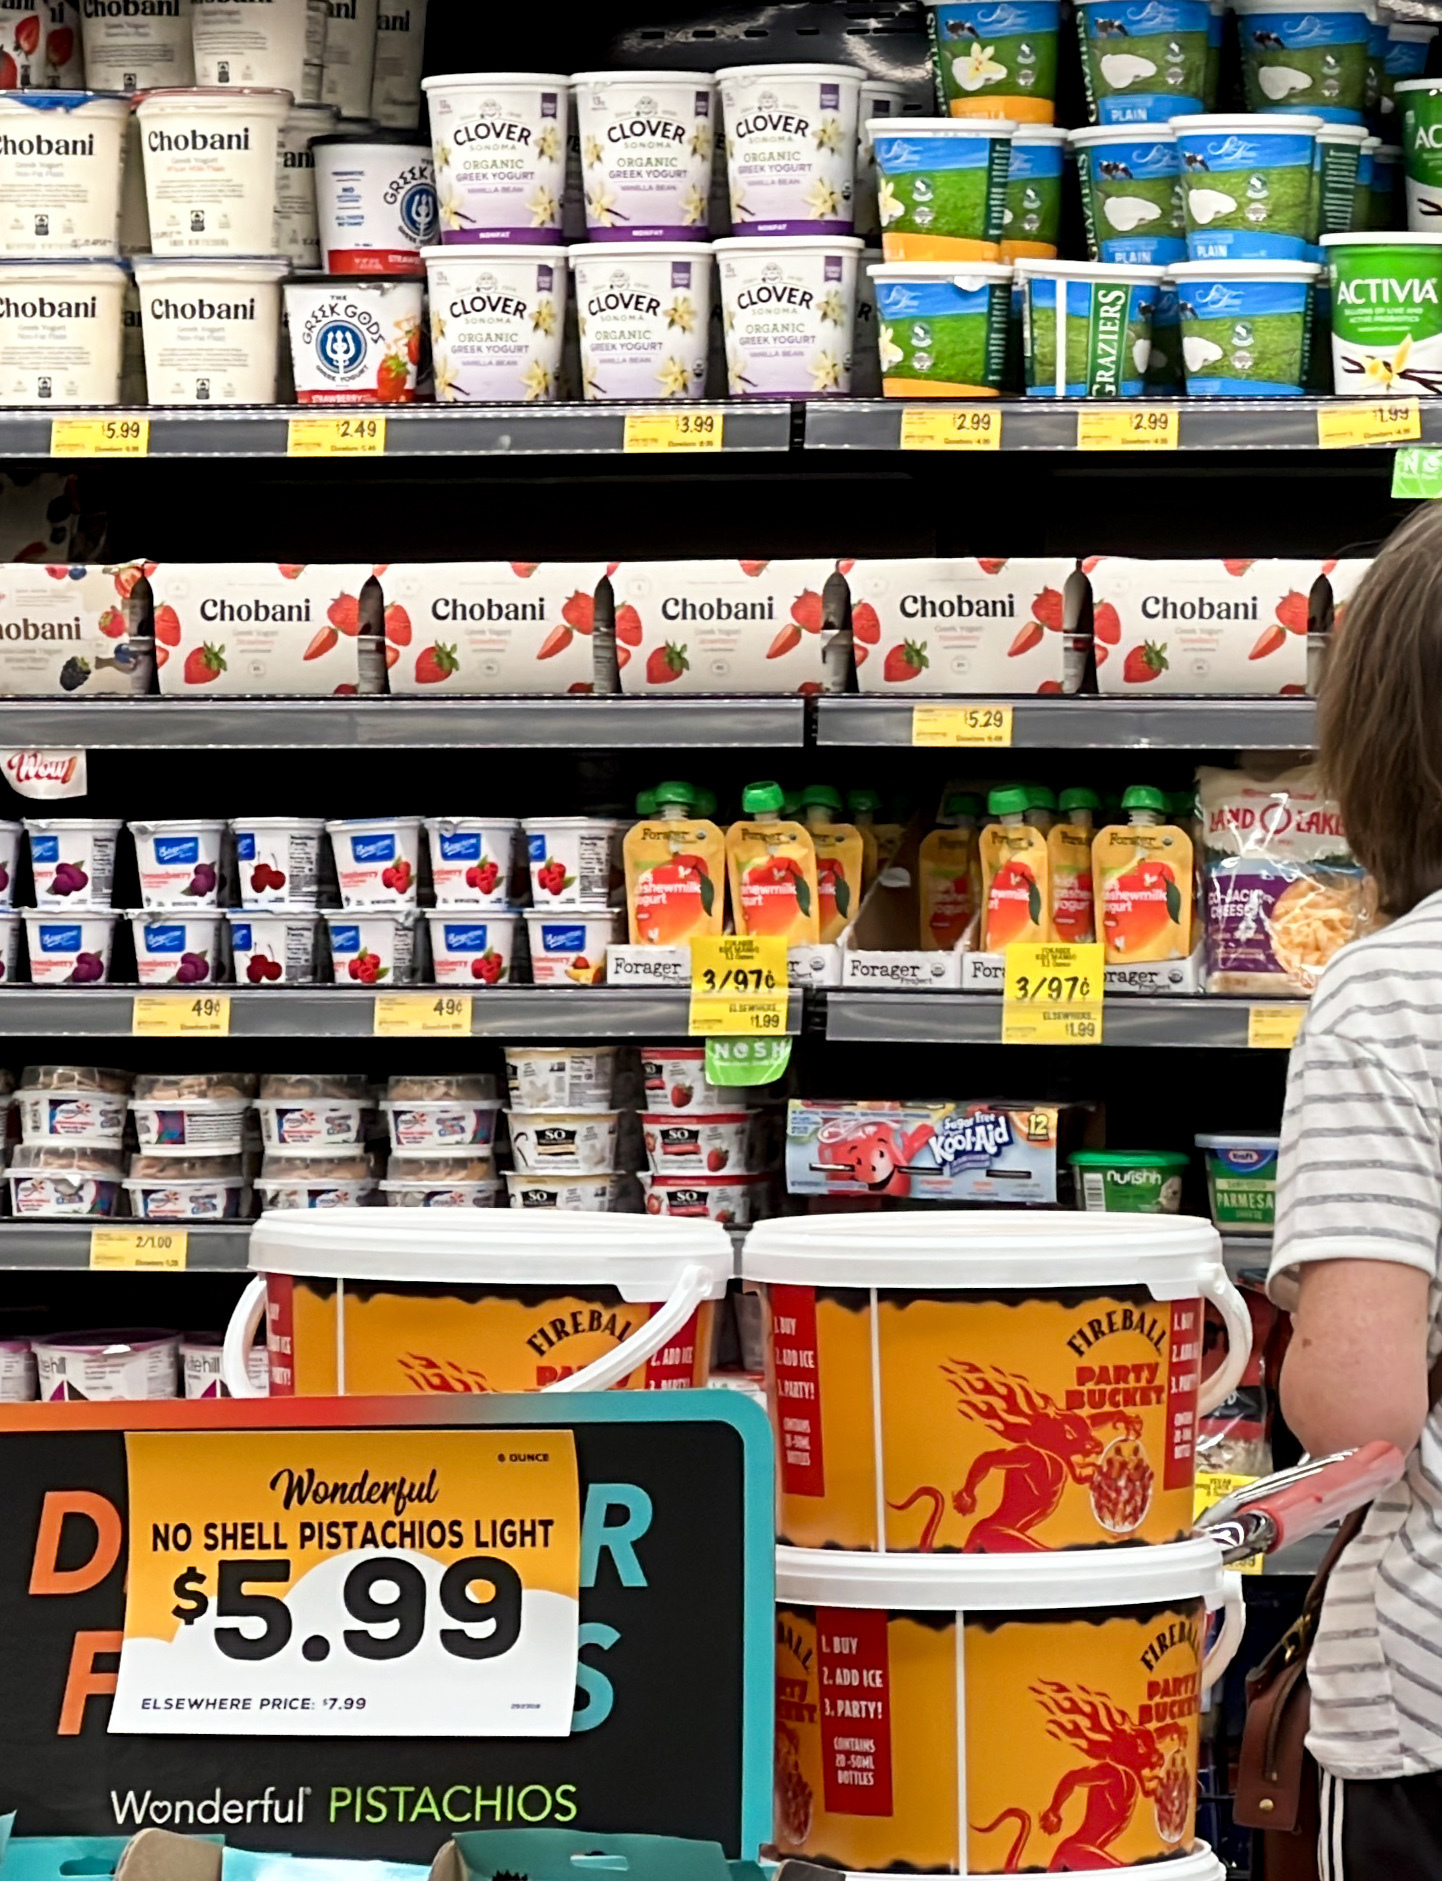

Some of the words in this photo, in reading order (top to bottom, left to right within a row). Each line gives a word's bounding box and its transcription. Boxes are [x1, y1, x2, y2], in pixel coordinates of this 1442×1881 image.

[1111, 108, 1147, 122] PLAIN
[453, 120, 531, 147] CLOVER
[607, 119, 686, 145] CLOVER
[735, 114, 810, 139] CLOVER
[148, 127, 250, 152] Chobani
[463, 157, 524, 170] ORGANIC
[617, 156, 678, 168] ORGANIC
[743, 151, 801, 163] ORGANIC
[456, 171, 489, 181] GREEK
[492, 171, 534, 181] YOGURT
[609, 170, 641, 180] GREEK
[645, 169, 688, 179] YOGURT
[738, 164, 768, 174] GREEK
[771, 163, 812, 172] YOGURT
[1115, 250, 1151, 264] PLAIN
[1197, 245, 1227, 257] PLAIN
[736, 285, 814, 312] CLOVER
[1337, 278, 1438, 304] ACTIVIA
[150, 298, 255, 321] Chobani
[449, 295, 528, 320] CLOVER
[587, 293, 661, 318] CLOVER
[458, 331, 518, 344] ORGANIC
[595, 330, 652, 341] ORGANIC
[745, 322, 805, 334] ORGANIC
[1092, 288, 1126, 395] GRAZIERS
[200, 598, 311, 622] Chobani
[431, 597, 546, 621] Chobani
[661, 597, 774, 621] Chobani
[899, 594, 1016, 618] Chobani
[1141, 597, 1258, 621] Chobani
[1209, 804, 1254, 834] LAND
[1297, 808, 1344, 838] LAKE
[613, 957, 682, 978] Forager
[851, 959, 921, 980] Forager
[703, 968, 775, 993] 3/97¢
[1015, 976, 1090, 1000] 3/97¢
[191, 998, 220, 1017] 49¢
[433, 998, 463, 1017] 49¢
[714, 1043, 788, 1059] NOSH
[1029, 1116, 1048, 1134] 12
[1107, 1170, 1162, 1185] nurishh
[1216, 1191, 1277, 1210] PARMESA
[136, 1236, 172, 1249] 2/1.00
[1066, 1308, 1167, 1357] FIREBALL
[1076, 1363, 1159, 1387] PARTY
[1066, 1386, 1164, 1411] BUCKET
[498, 1453, 506, 1462] 6
[510, 1453, 549, 1462] OUNCE
[270, 1468, 439, 1516] Wonderful
[152, 1524, 192, 1551] NO
[204, 1522, 287, 1550] SHELL
[300, 1520, 463, 1550] PISTACHIOS
[475, 1519, 553, 1548] LIGHT
[171, 1555, 523, 1662] $5.99
[833, 1637, 857, 1654] BUY
[835, 1668, 860, 1686] ADD
[863, 1670, 883, 1688] ICE
[141, 1697, 251, 1711] ELSEWHERE
[260, 1697, 315, 1711] PRICE:
[322, 1697, 366, 1711] $7.99
[837, 1700, 882, 1719] PARTY!
[834, 1737, 875, 1751] CONTAINS
[837, 1771, 874, 1785] BOTTLES
[111, 1788, 304, 1825] Wonderful
[329, 1784, 577, 1822] PISTACHIOS
